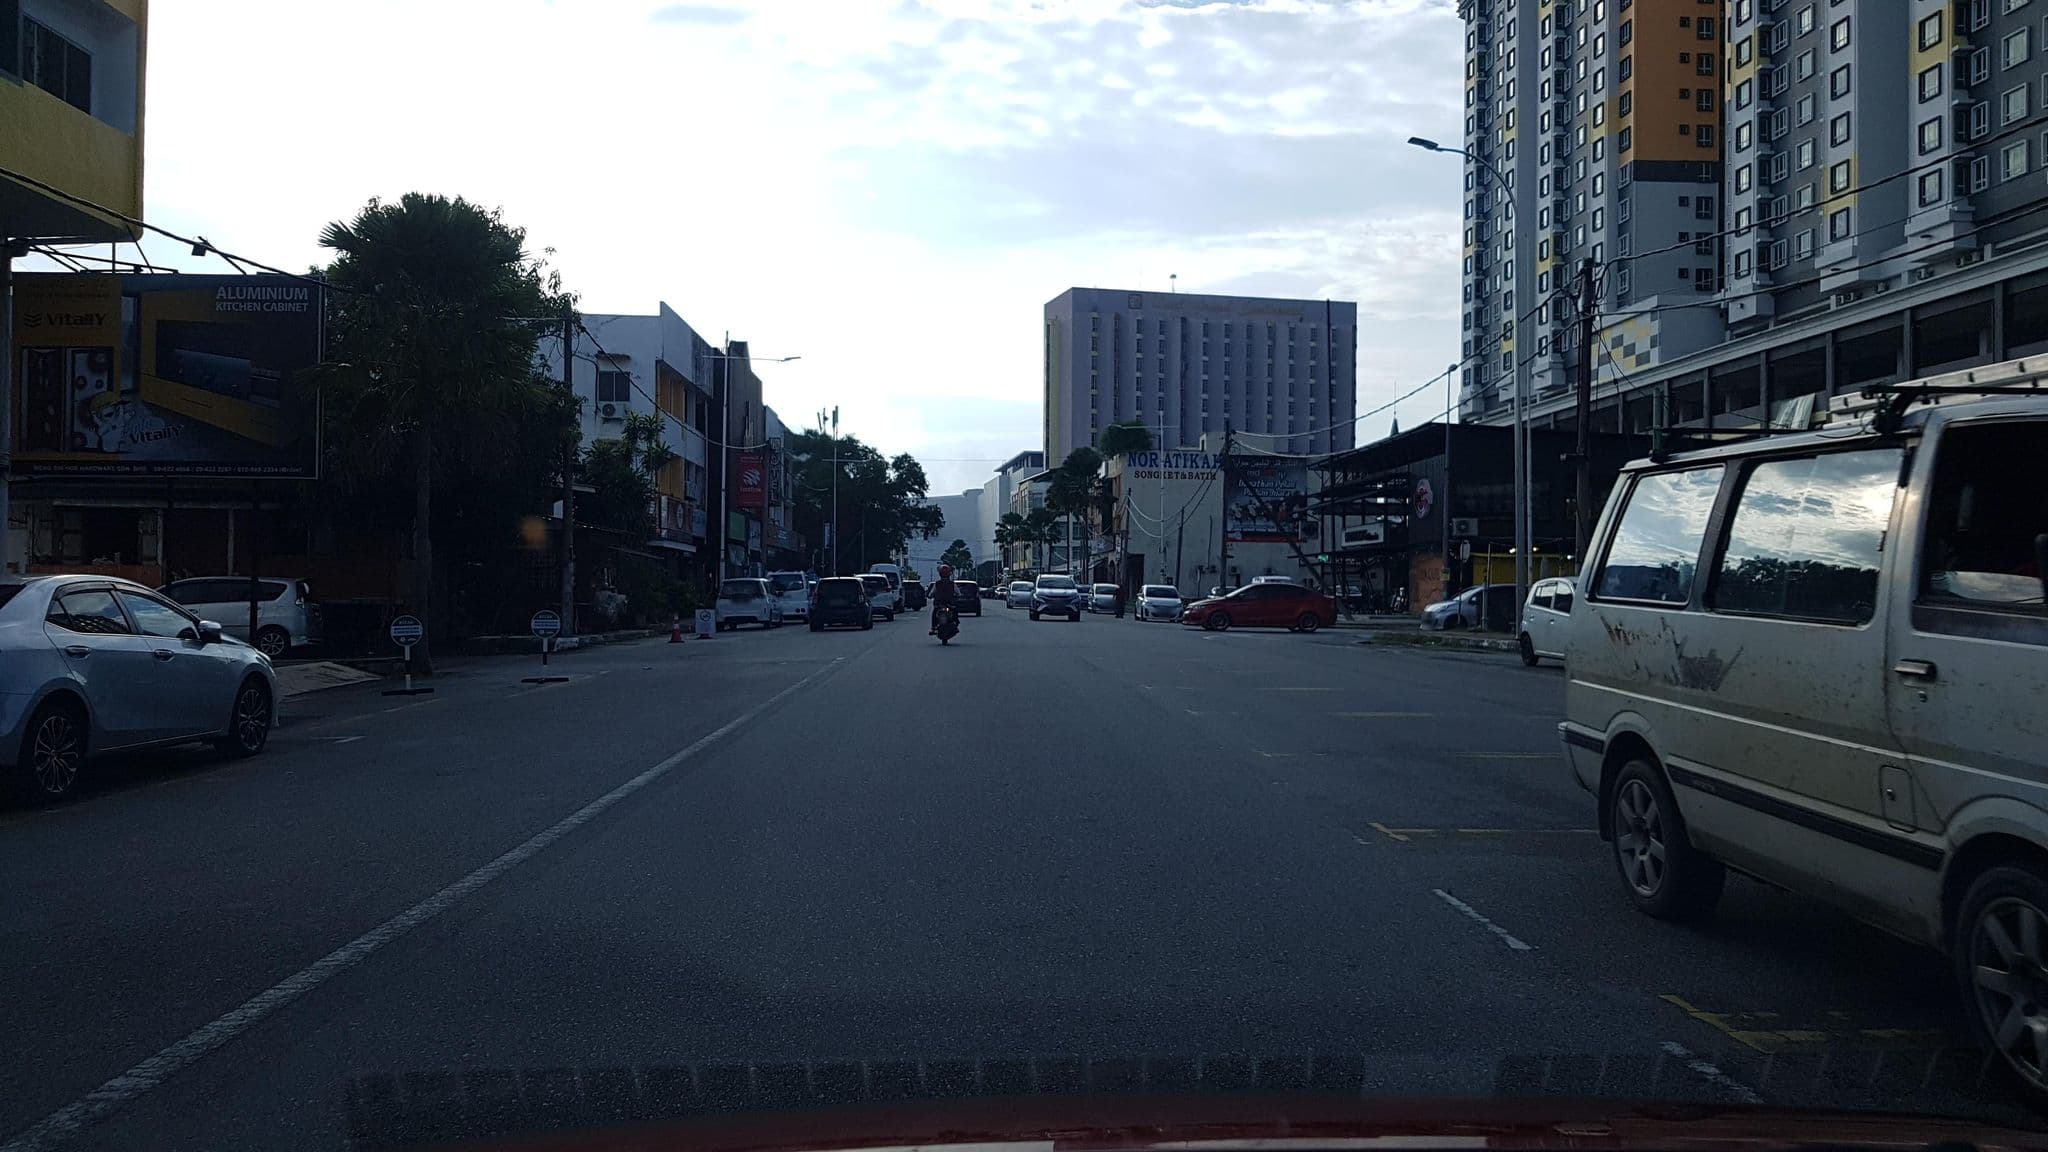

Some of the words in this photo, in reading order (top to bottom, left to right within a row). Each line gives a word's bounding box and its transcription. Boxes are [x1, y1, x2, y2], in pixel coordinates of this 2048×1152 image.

[216, 286, 308, 300] ALUMINIUM
[216, 301, 260, 312] KITCHEN
[263, 302, 309, 313] CABINET
[1128, 451, 1159, 468] NOR
